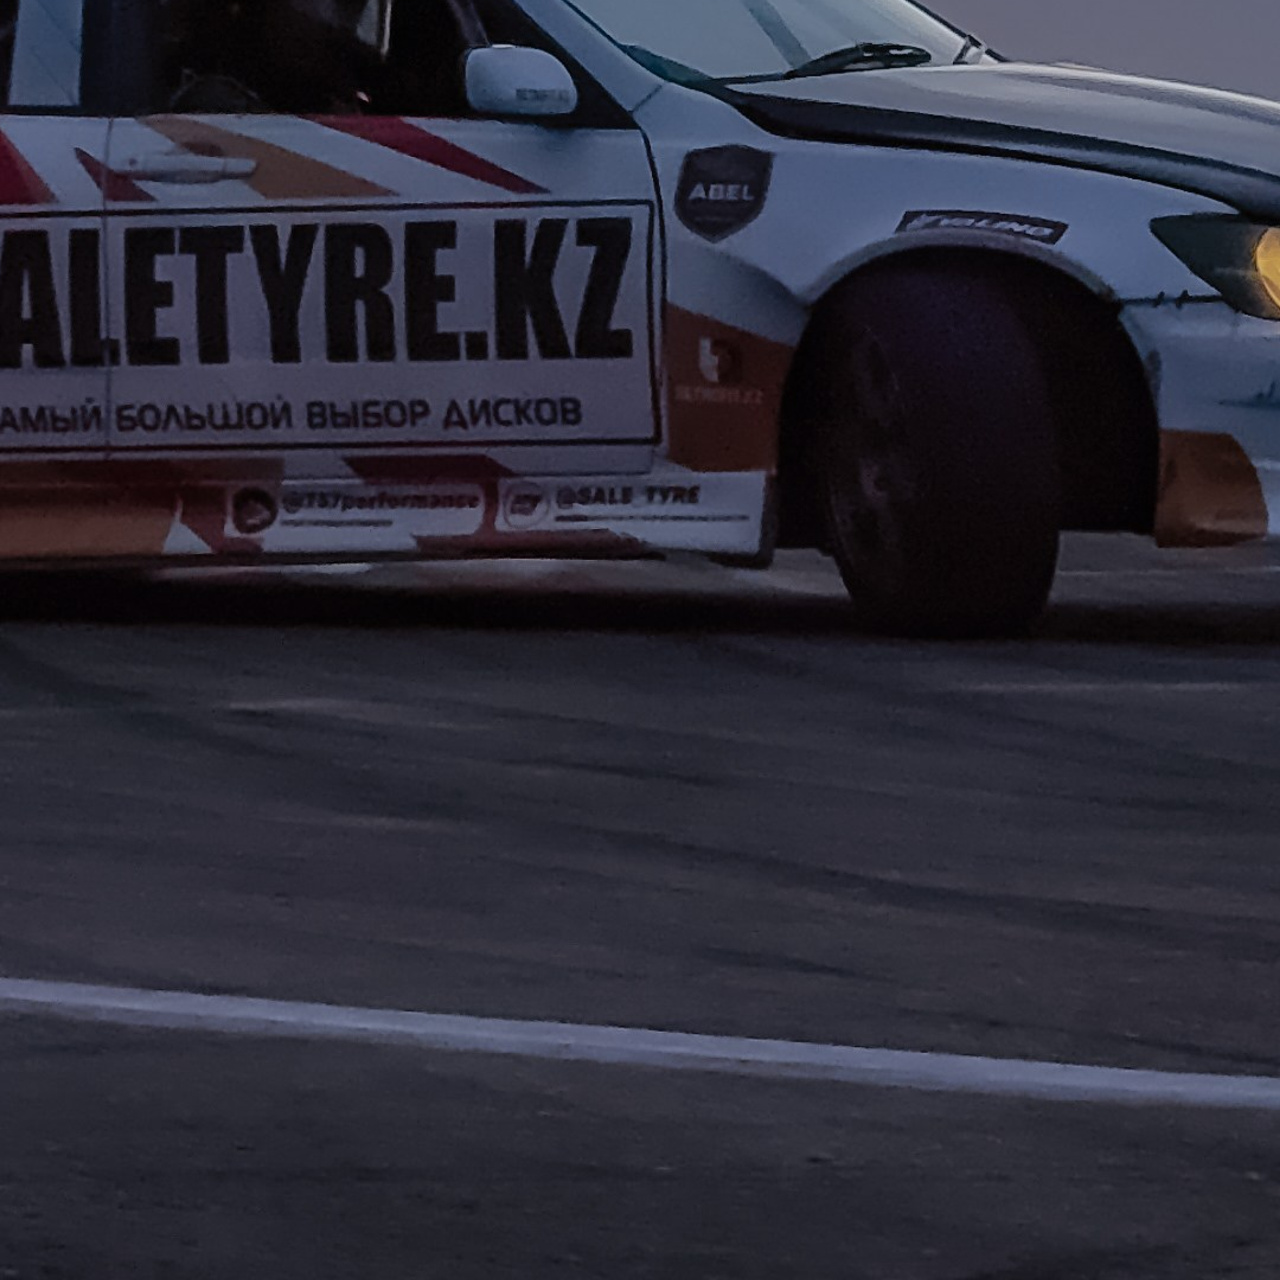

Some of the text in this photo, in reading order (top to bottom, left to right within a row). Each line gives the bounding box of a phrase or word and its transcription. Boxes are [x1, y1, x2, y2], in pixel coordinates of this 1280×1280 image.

[687, 181, 755, 201] ABEL
[115, 394, 293, 432] БОЛЬШОЙ
[306, 398, 431, 431] ВЫБОР
[442, 397, 583, 431] ДИСКОВ
